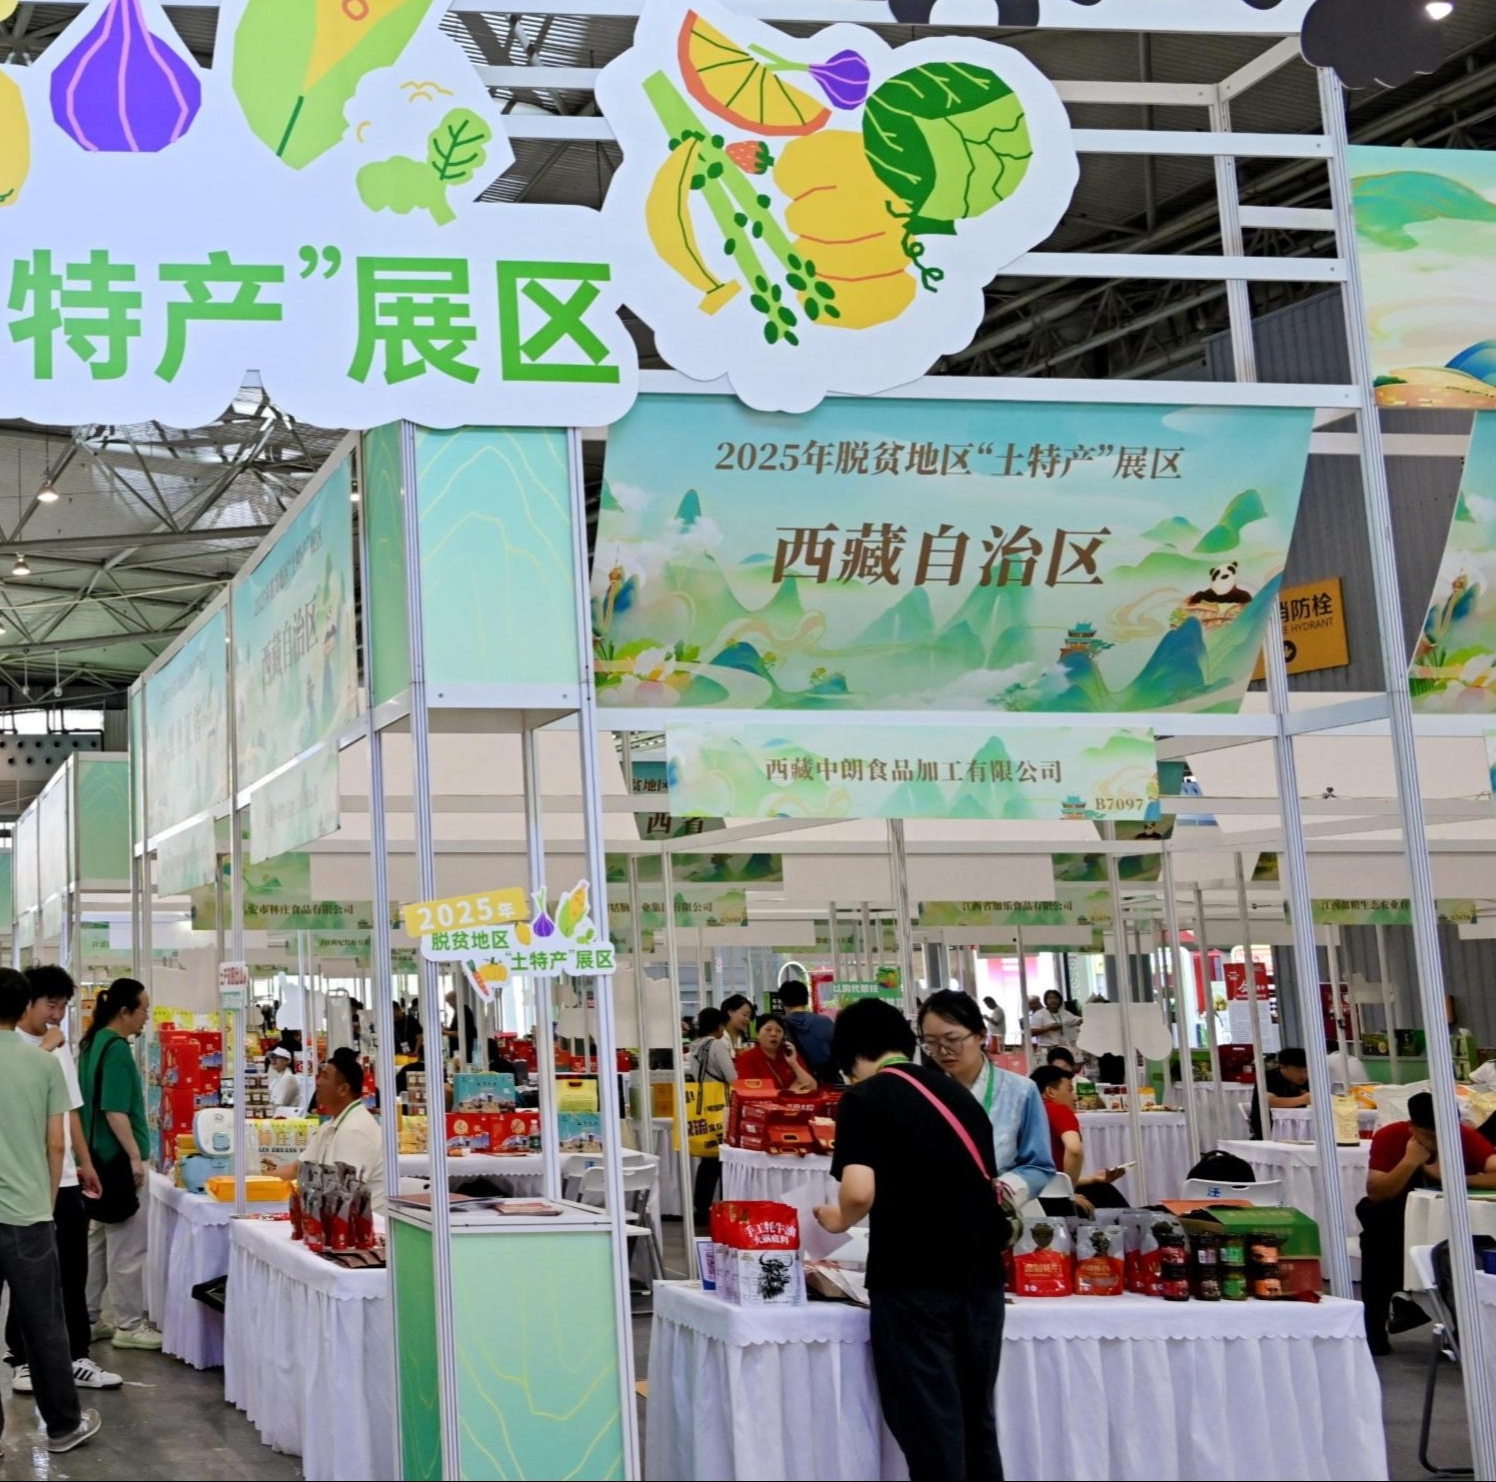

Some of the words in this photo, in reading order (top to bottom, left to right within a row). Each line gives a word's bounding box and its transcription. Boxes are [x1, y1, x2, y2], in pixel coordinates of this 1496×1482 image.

[714, 439, 1186, 482] 2025年脱贫地区“土特产”展区
[770, 523, 1113, 588] 西藏自治区
[1291, 617, 1333, 633] HYDRANT
[764, 756, 1064, 784] 西藏中朗食品加工有限公司
[1094, 796, 1145, 813] B7097
[416, 897, 515, 931] 2025年
[431, 930, 510, 951] 脱贫地区
[505, 949, 614, 971] “土特产”展区
